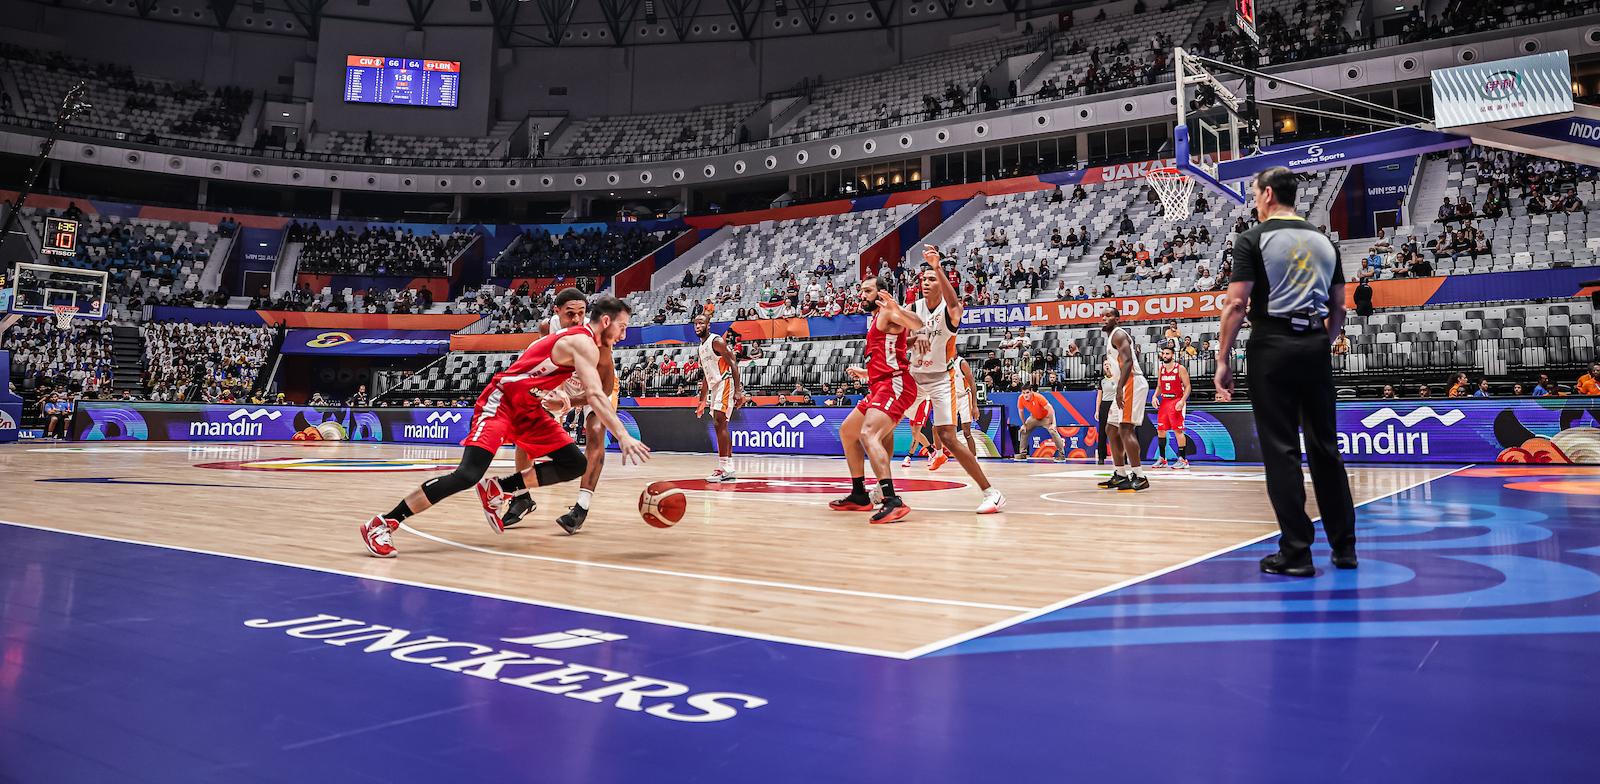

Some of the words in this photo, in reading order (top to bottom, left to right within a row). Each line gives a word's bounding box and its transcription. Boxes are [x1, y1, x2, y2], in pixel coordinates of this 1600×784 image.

[394, 74, 413, 82] 1:36
[1569, 122, 1600, 140] INDO
[1288, 157, 1319, 167] Schelde
[1319, 152, 1345, 162] Sports
[1367, 187, 1385, 196] WIN
[57, 222, 75, 232] 1:35
[55, 232, 73, 248] 10
[1058, 299, 1139, 320] WORLD
[1144, 296, 1194, 315] CUP
[1165, 382, 1171, 390] 5
[18, 431, 35, 439] ALL
[189, 418, 263, 436] mandiri
[404, 421, 449, 439] mandiri
[731, 425, 805, 448] mandiri
[1299, 424, 1430, 455] andiri
[243, 614, 769, 723] JUNCKERS
